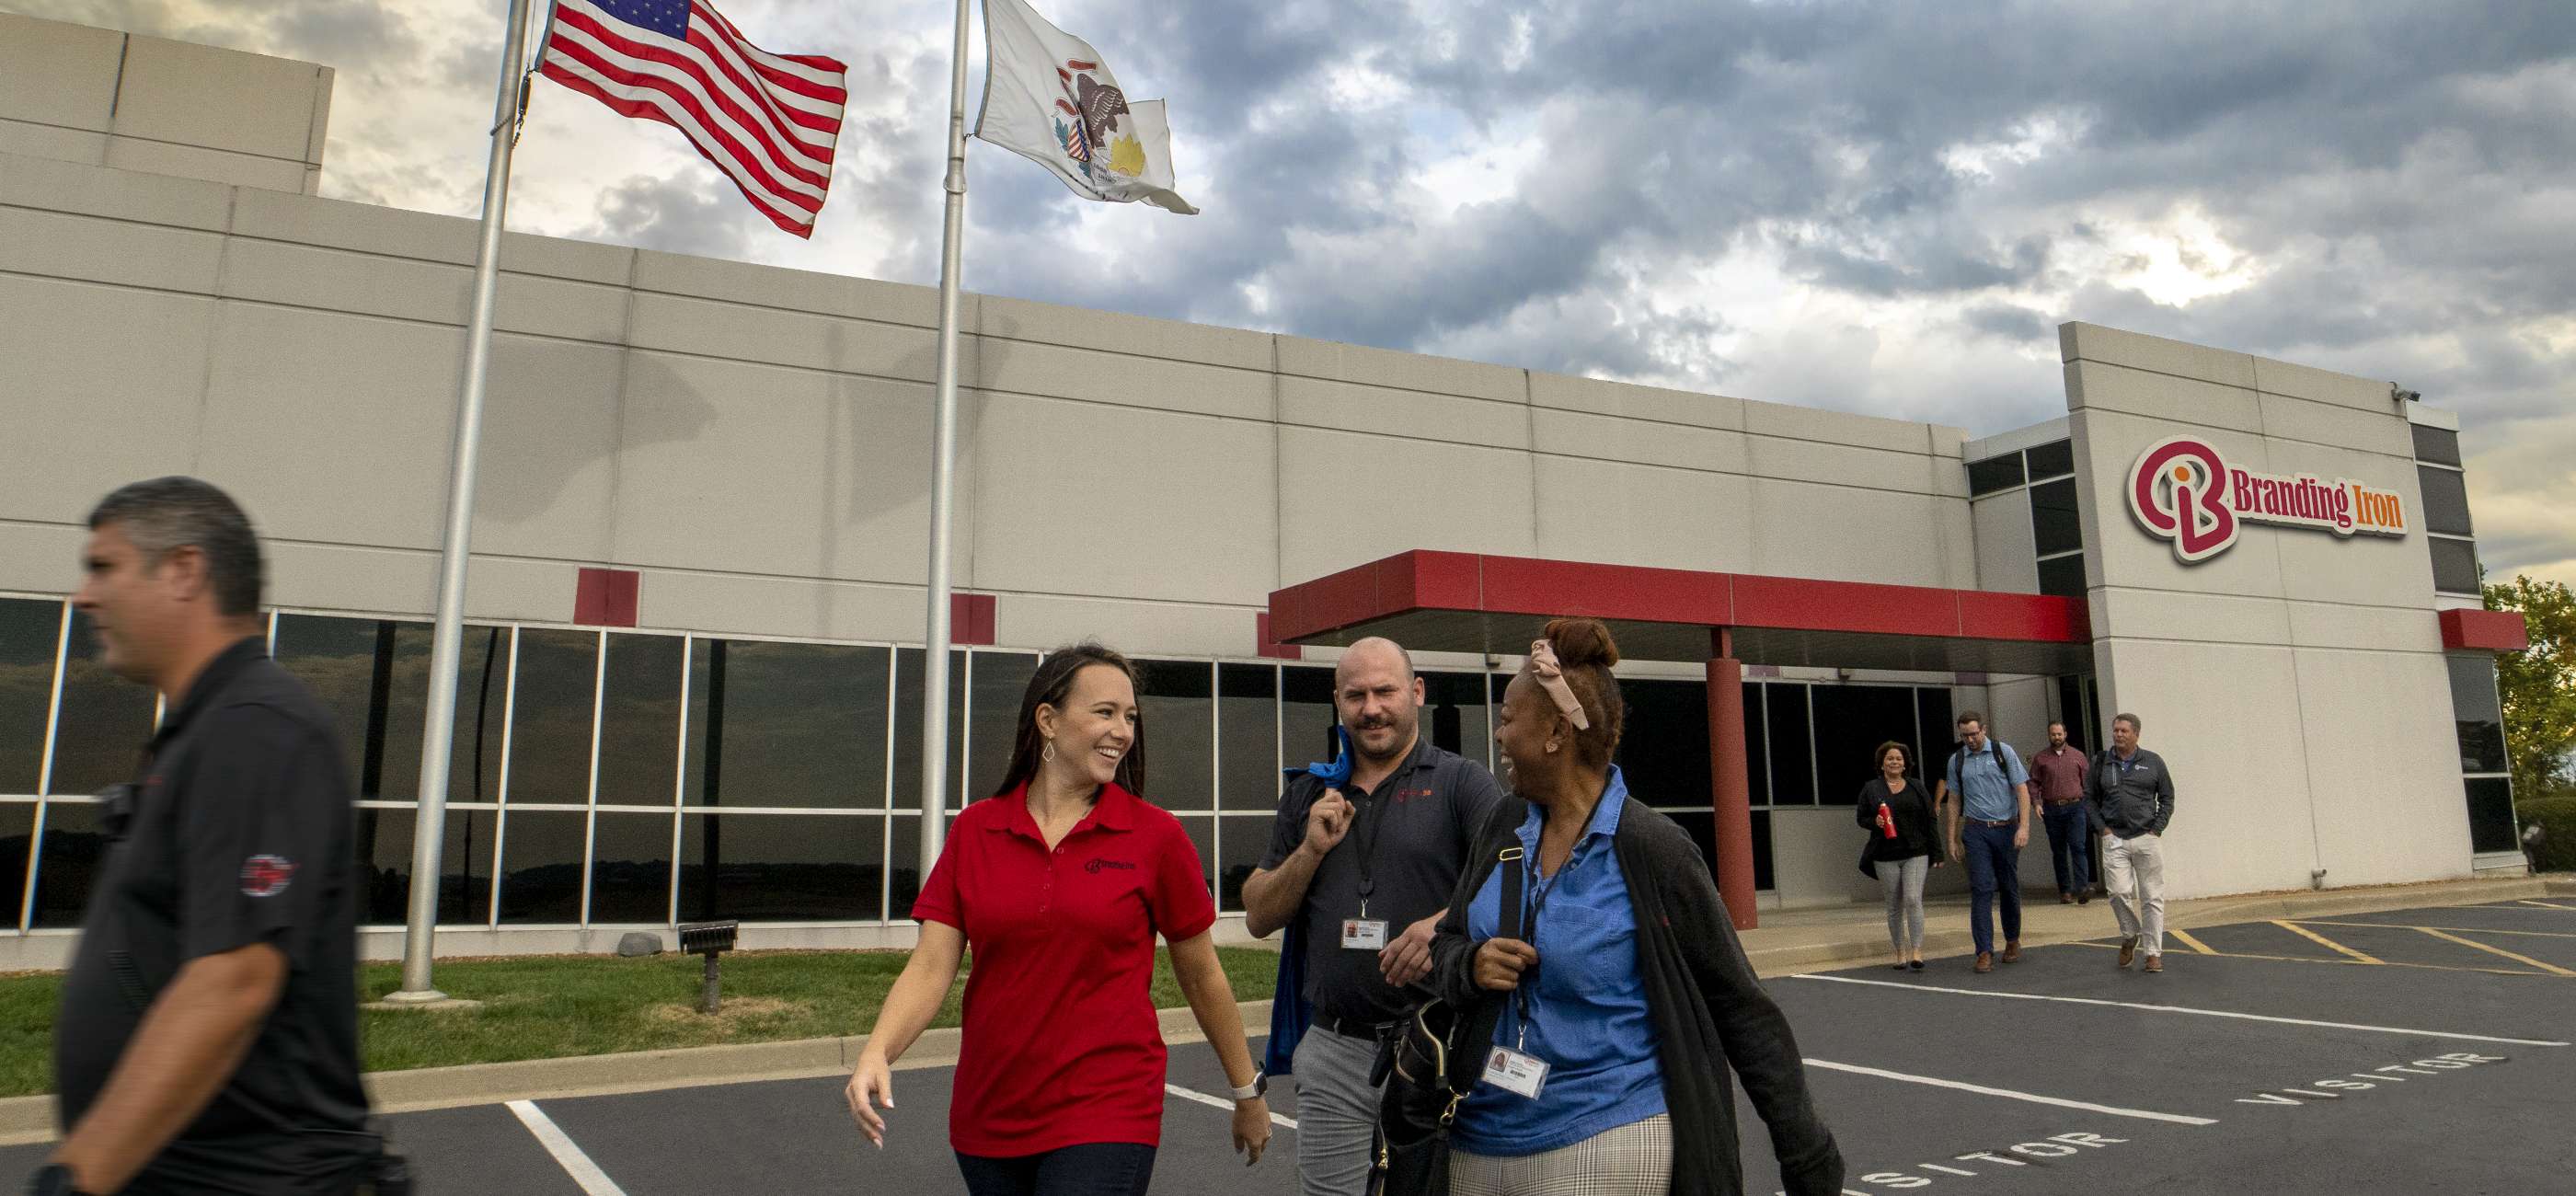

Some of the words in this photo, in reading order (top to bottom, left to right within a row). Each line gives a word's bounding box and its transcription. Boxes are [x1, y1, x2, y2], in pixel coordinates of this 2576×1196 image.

[2230, 468, 2352, 528] Branding
[2352, 484, 2404, 529] Iron
[2234, 1052, 2507, 1105] VISITOR
[1776, 1132, 2130, 1196] ISITOR
